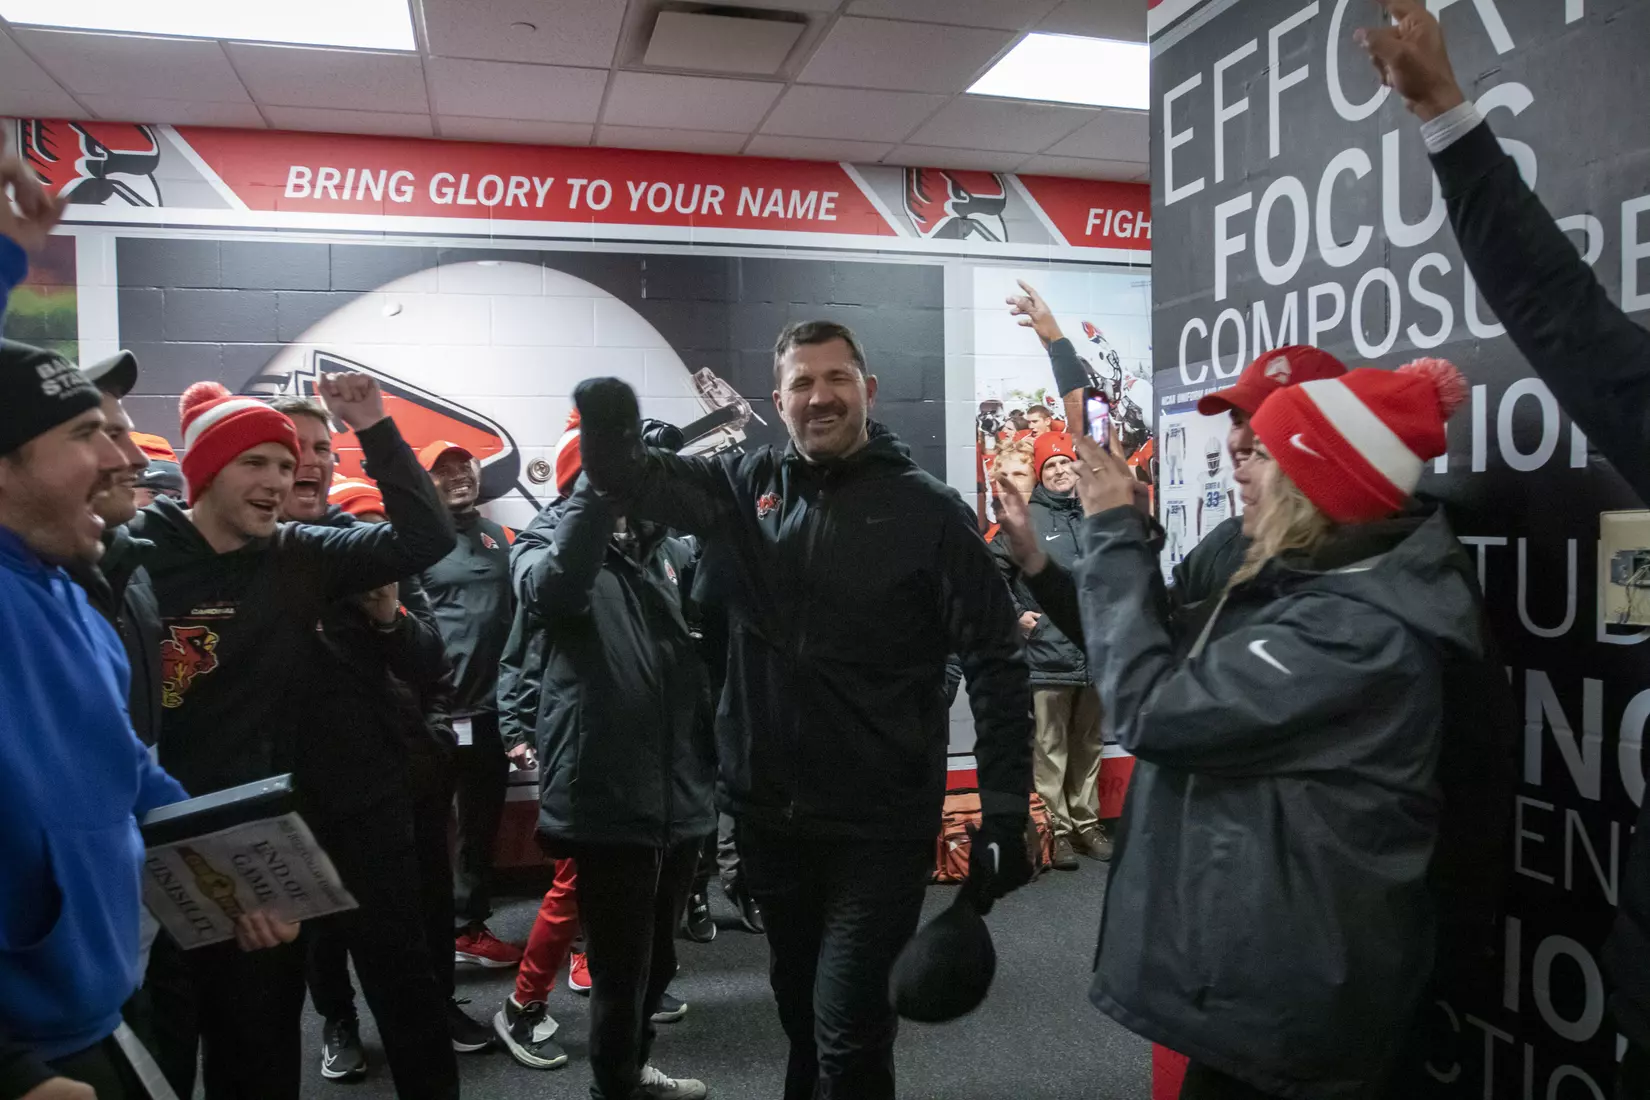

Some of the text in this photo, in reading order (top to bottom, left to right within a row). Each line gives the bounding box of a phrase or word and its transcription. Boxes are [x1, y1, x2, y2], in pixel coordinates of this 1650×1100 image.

[284, 165, 839, 222] BRING GLORY TO YOUR NAME
[1206, 491, 1220, 508] 33
